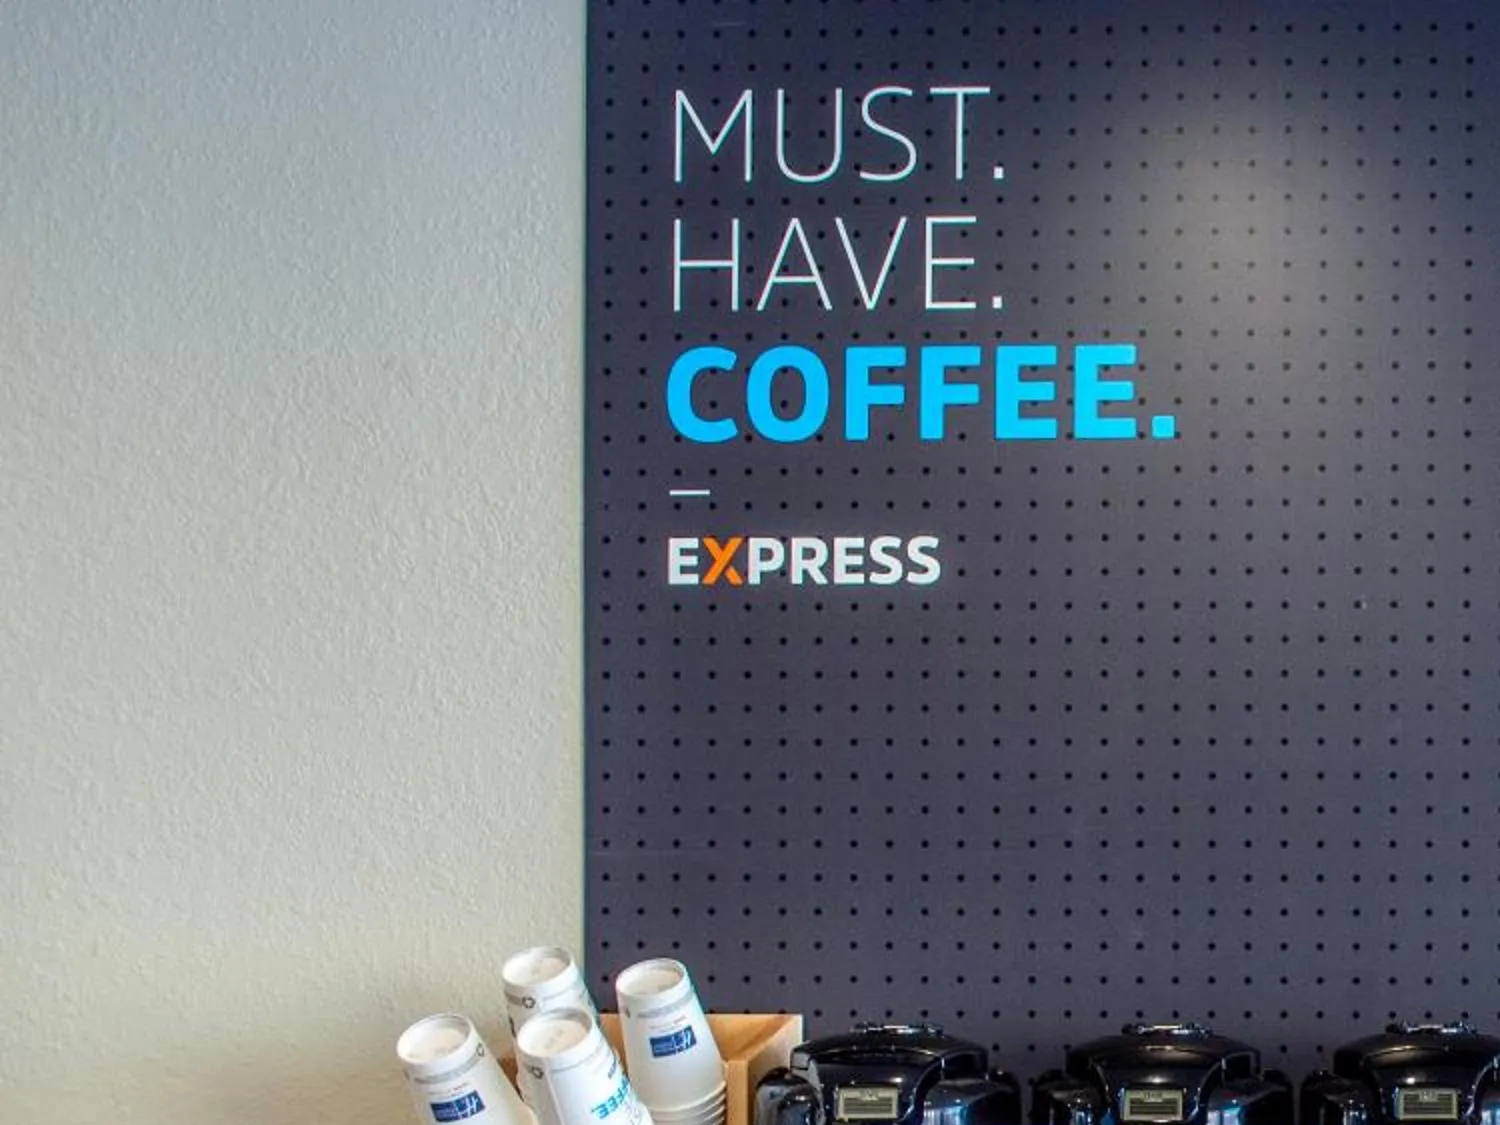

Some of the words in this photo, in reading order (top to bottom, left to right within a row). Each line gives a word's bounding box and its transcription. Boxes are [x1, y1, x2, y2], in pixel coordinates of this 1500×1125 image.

[674, 86, 1004, 183] MUST.
[673, 216, 1003, 312] HAVE.
[666, 344, 1175, 443] COFFEE.
[668, 535, 941, 585] EXPRESS
